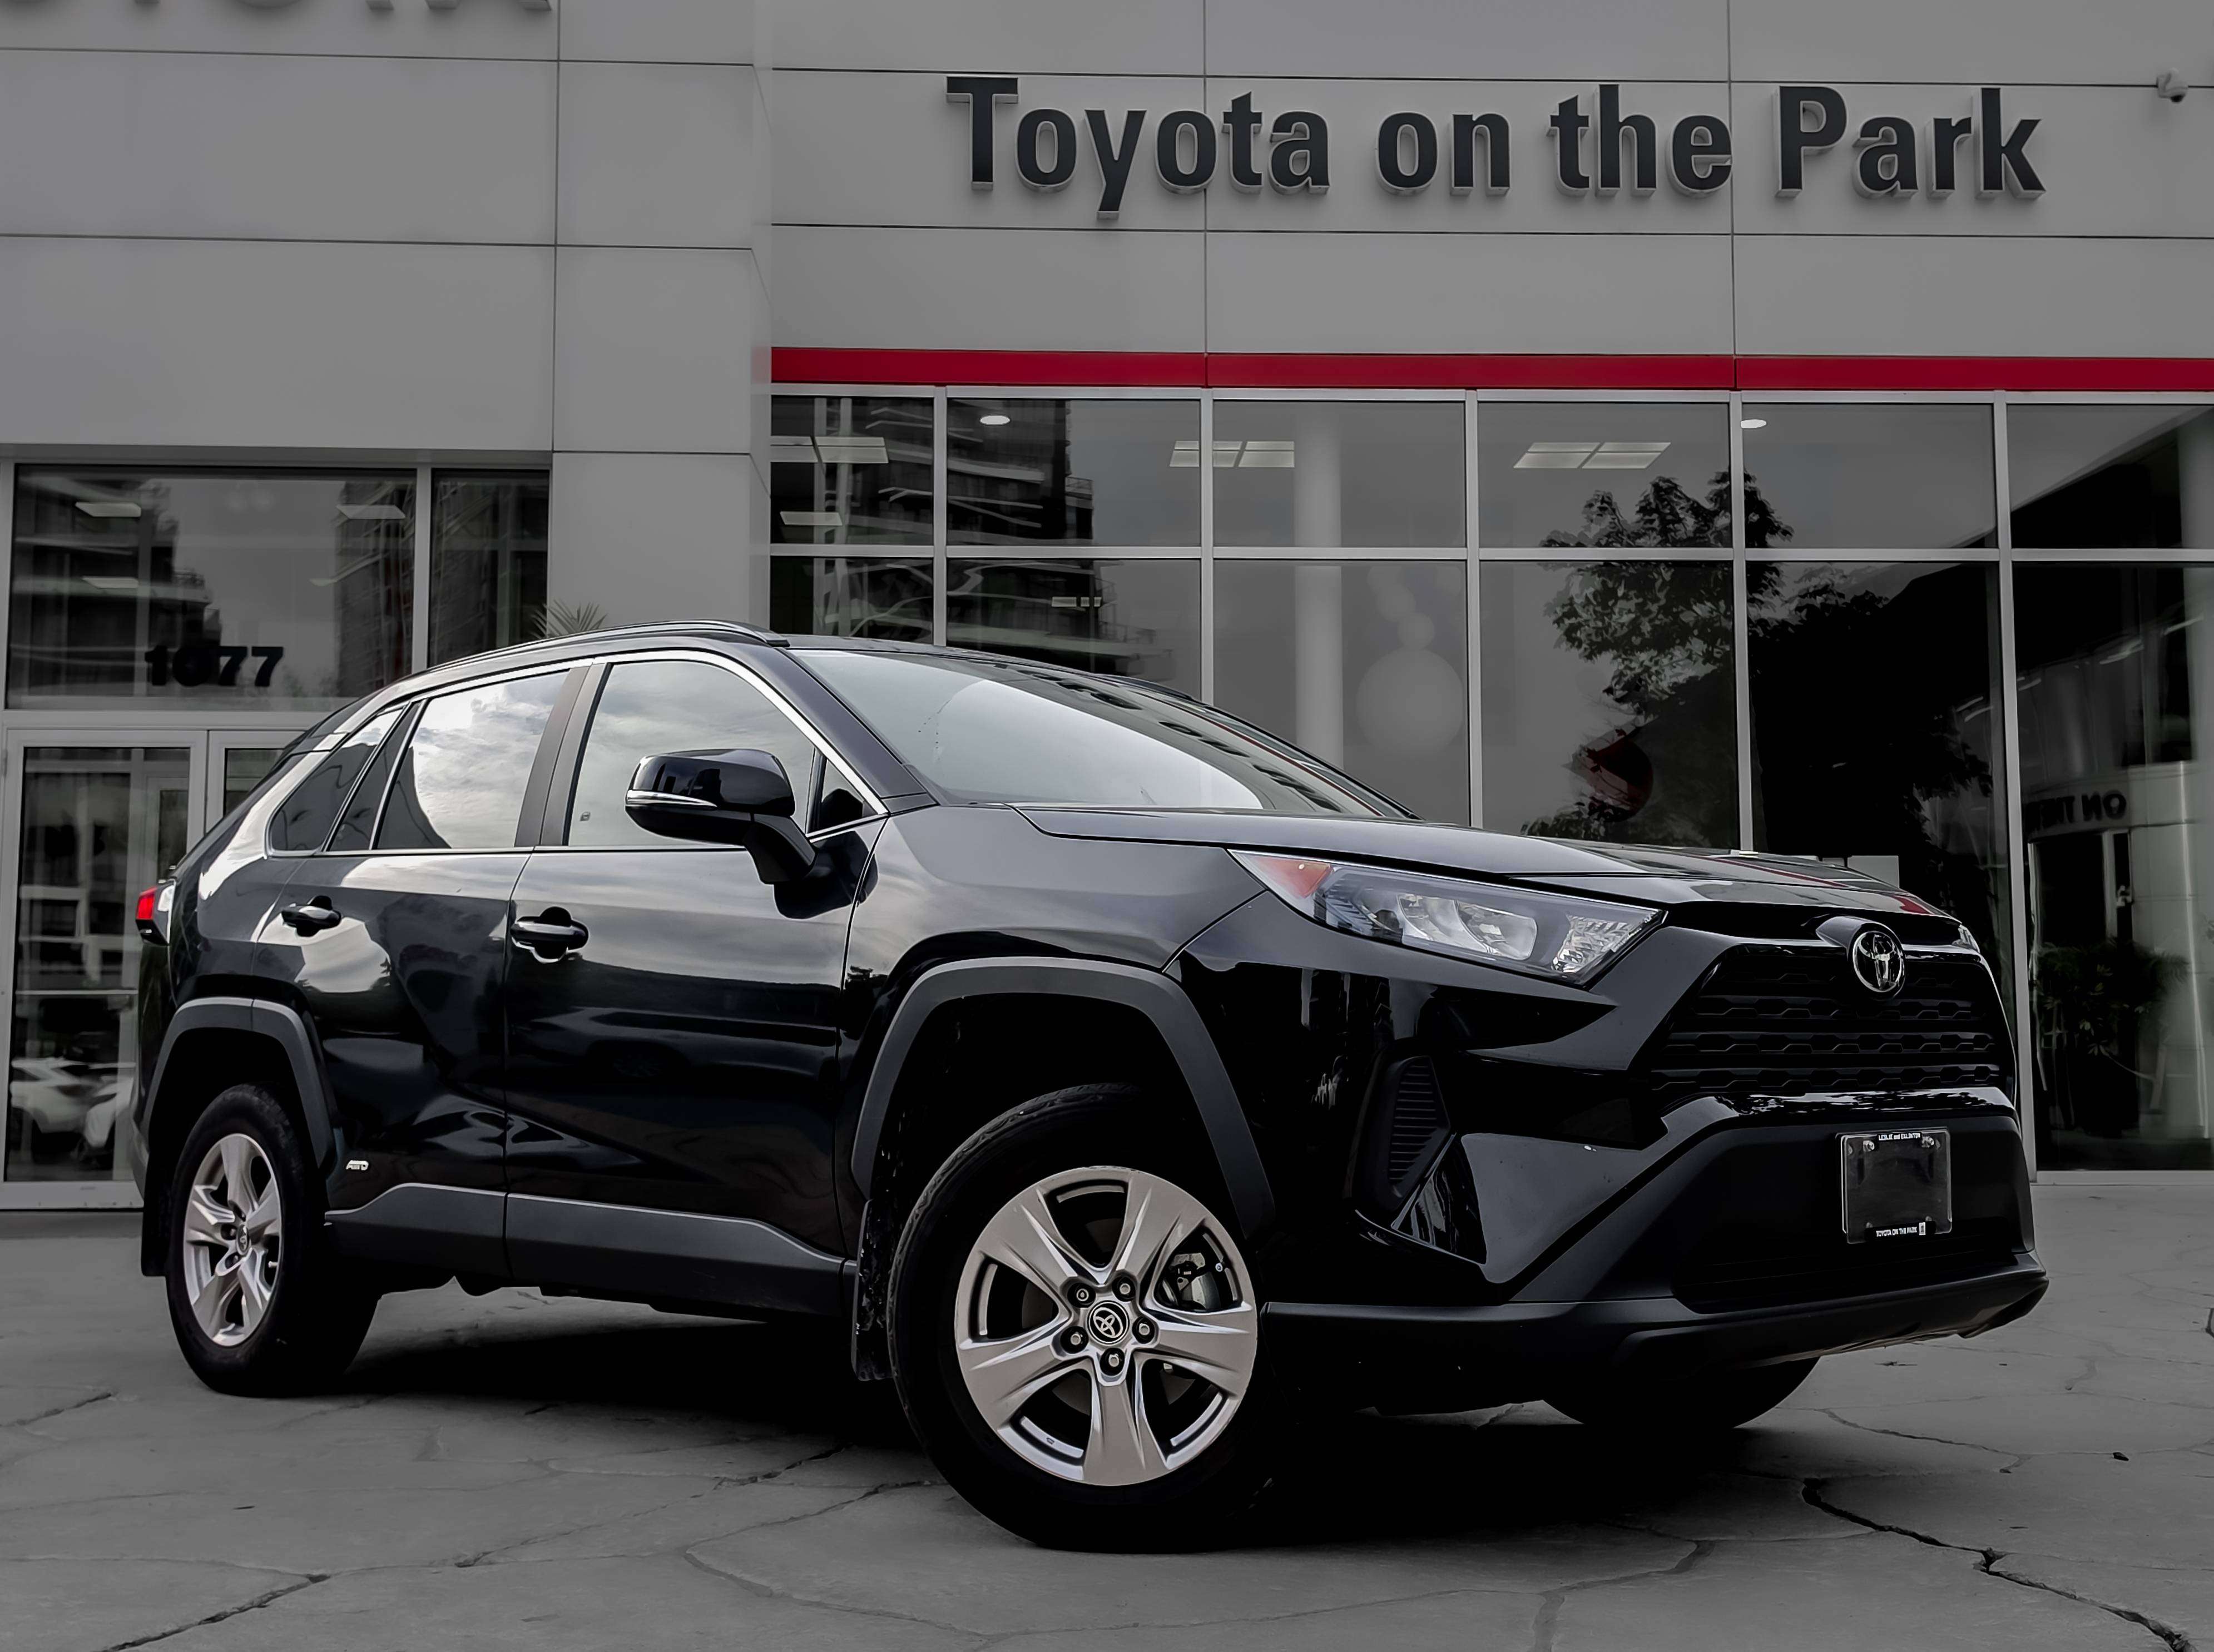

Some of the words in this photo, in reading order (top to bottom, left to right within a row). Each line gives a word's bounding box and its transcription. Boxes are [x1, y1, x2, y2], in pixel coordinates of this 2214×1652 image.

[945, 76, 1330, 219] Toyota
[1376, 112, 1509, 195] on
[1548, 83, 1732, 196] the
[1776, 86, 2045, 197] Park
[145, 646, 284, 687] 1077
